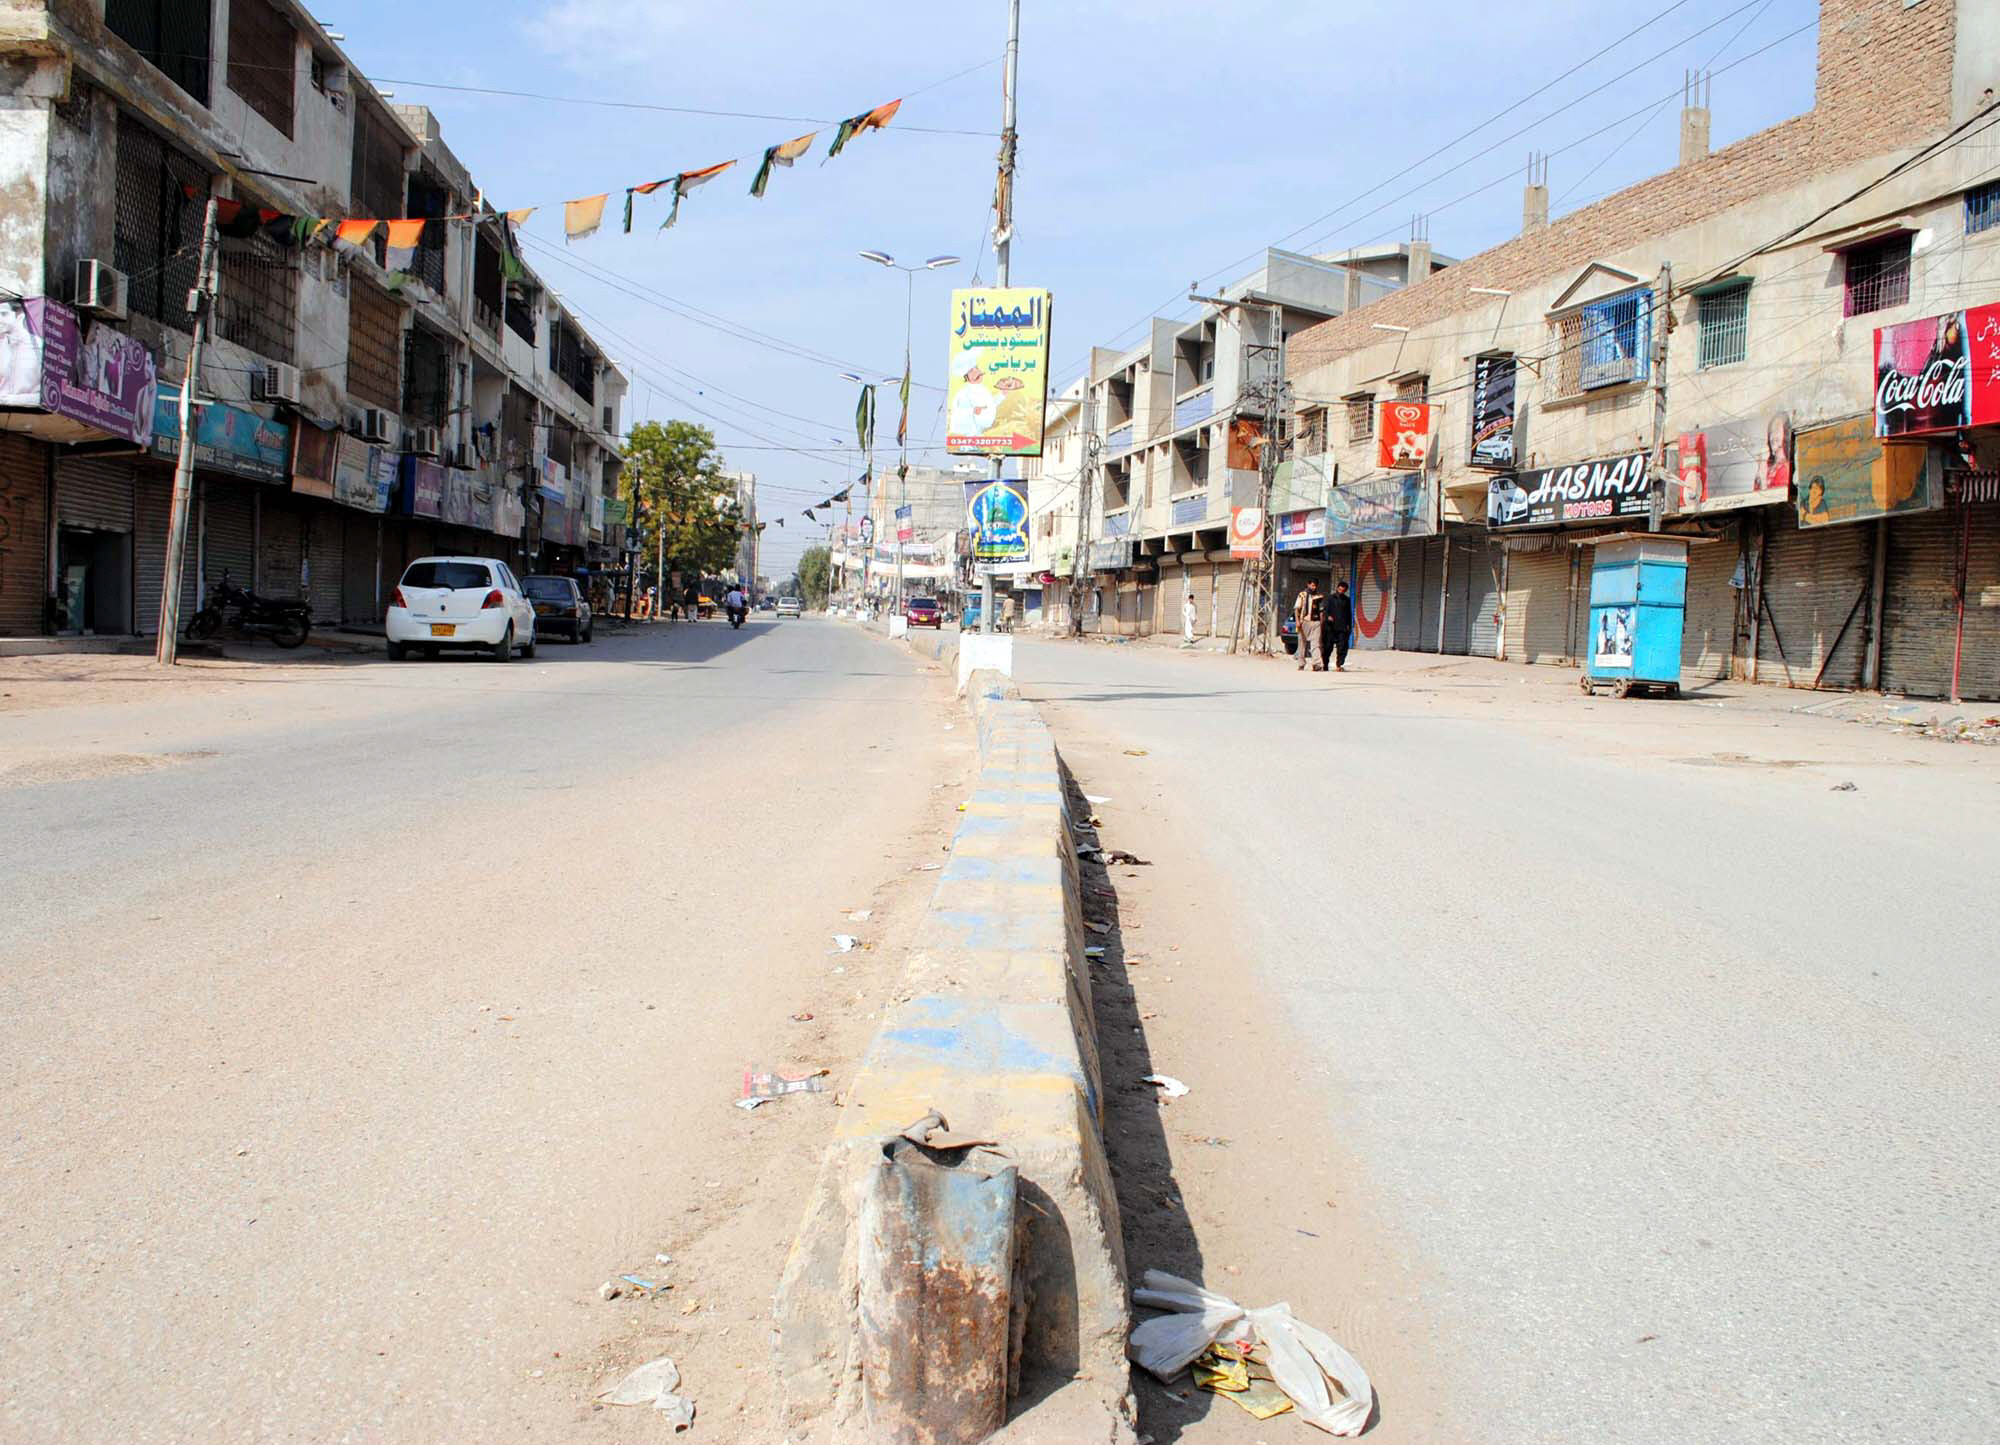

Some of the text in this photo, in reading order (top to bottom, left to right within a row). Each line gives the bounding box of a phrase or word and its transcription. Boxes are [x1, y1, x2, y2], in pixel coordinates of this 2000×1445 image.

[954, 296, 1042, 336] الممتاز
[1877, 356, 1968, 414] Coca-Cola
[1563, 499, 1612, 518] MOTORS
